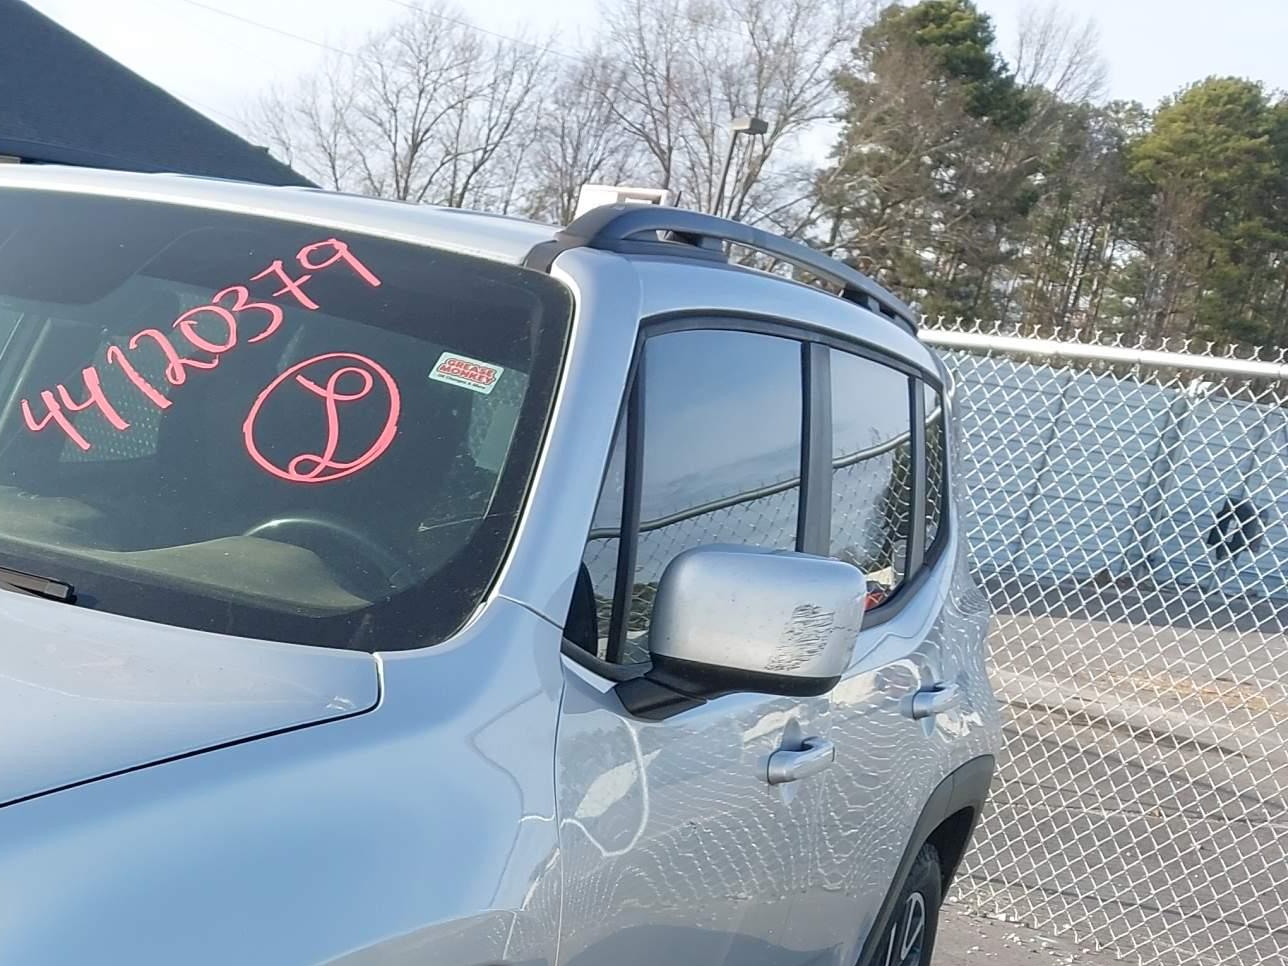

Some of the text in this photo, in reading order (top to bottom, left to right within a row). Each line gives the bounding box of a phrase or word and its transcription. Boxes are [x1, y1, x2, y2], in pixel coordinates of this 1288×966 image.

[23, 239, 378, 449] 44120379
[439, 365, 495, 385] MONKEY
[447, 359, 495, 377] GREASE
